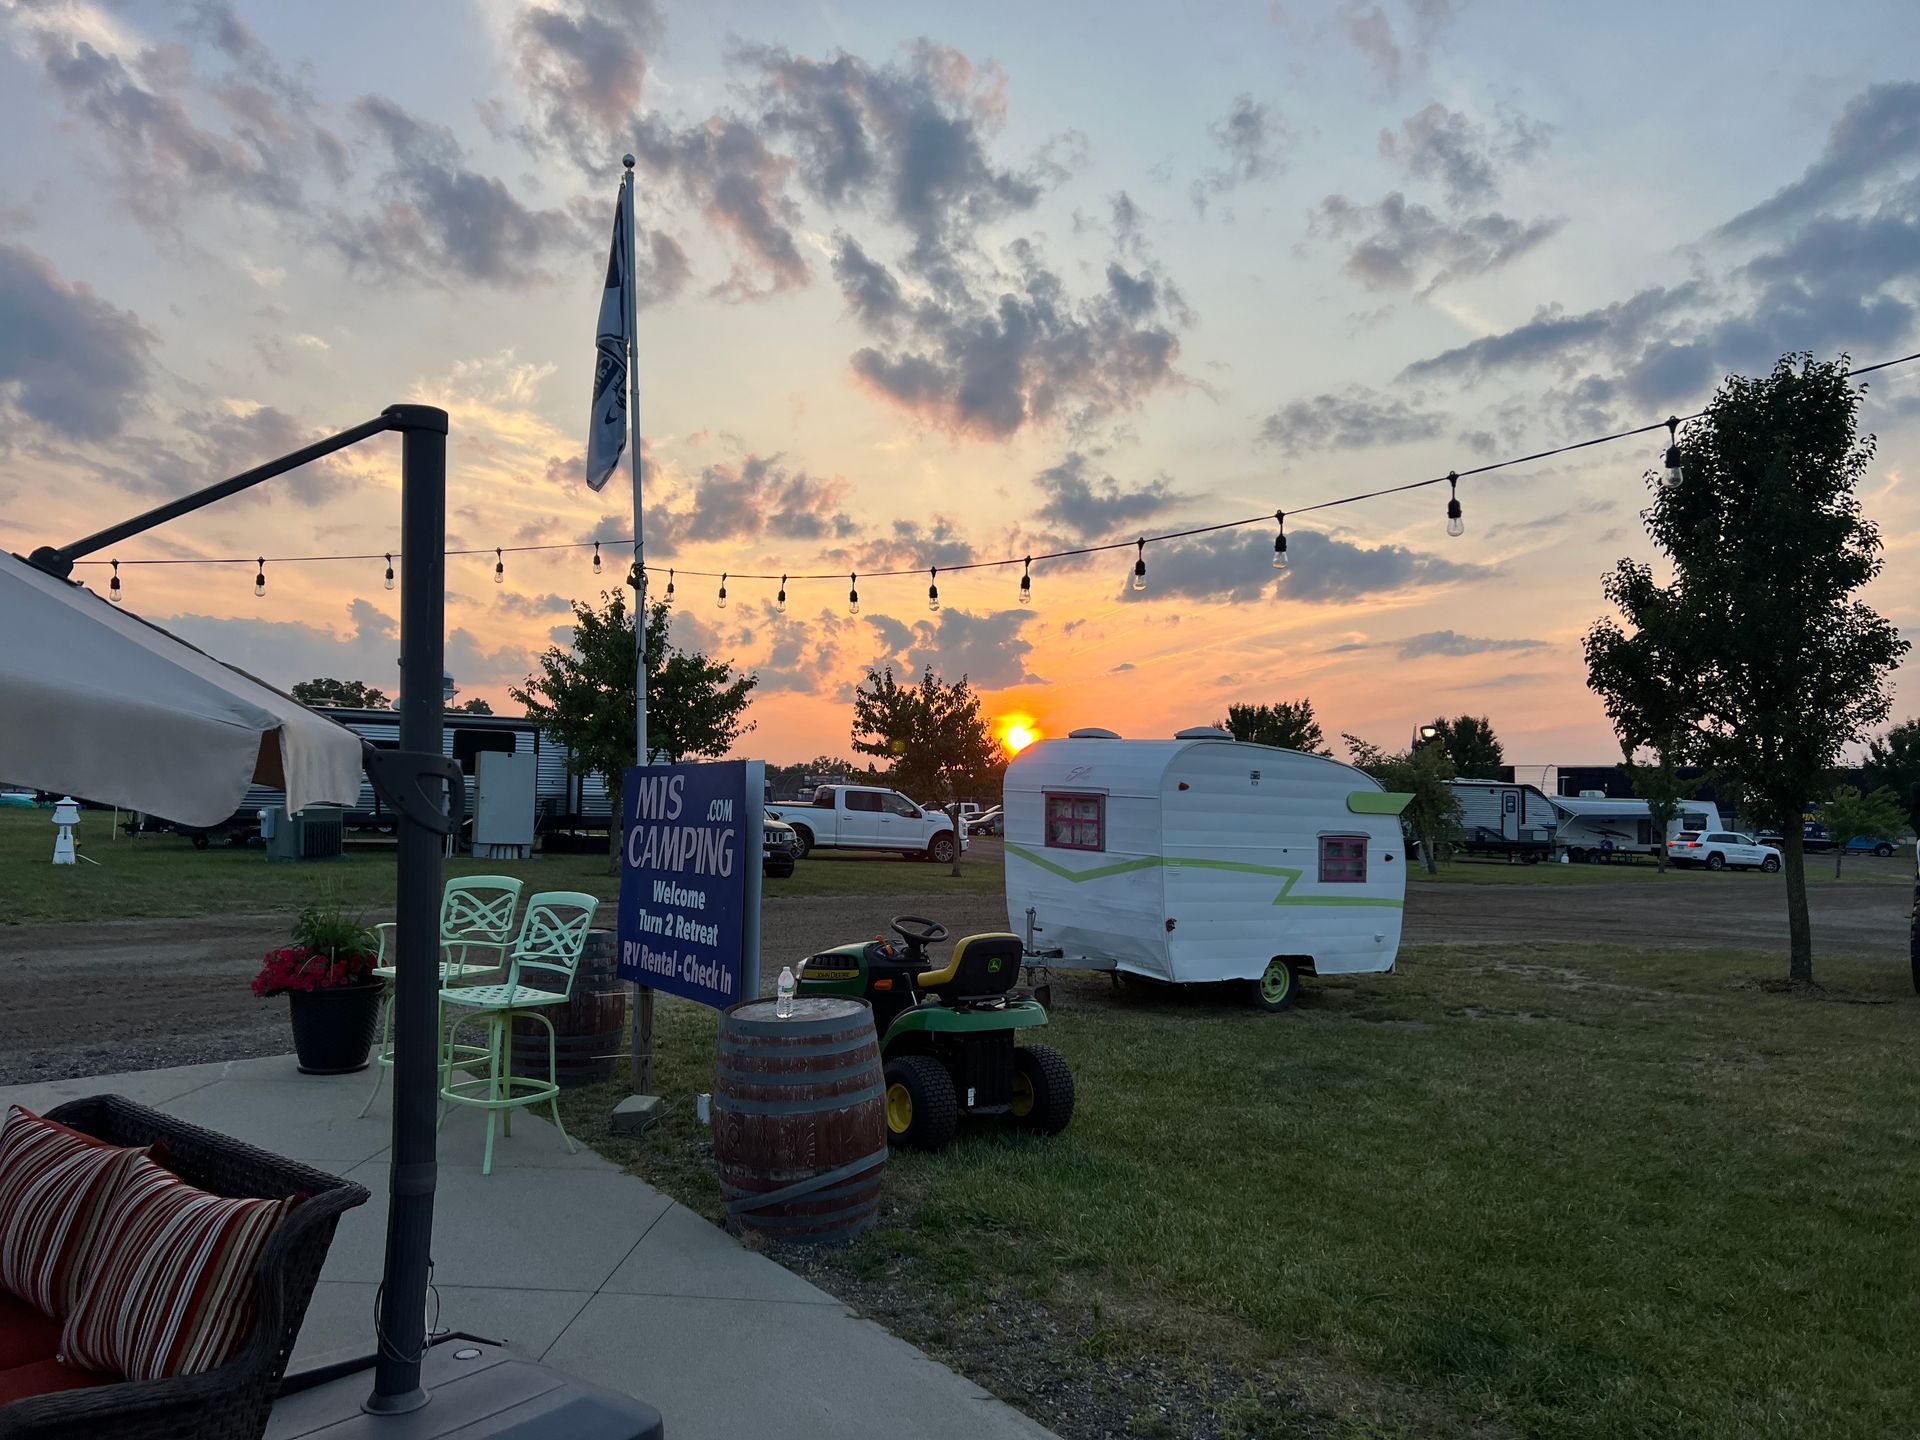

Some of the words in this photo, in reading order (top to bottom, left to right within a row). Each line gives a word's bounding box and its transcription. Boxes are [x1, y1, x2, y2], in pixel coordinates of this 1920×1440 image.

[636, 774, 685, 820] MIS
[706, 799, 733, 822] .COM
[628, 825, 735, 877] CAMPING
[653, 880, 706, 910] Welcome
[639, 908, 663, 934] Turn
[664, 913, 674, 937] 2
[675, 915, 719, 947] Retreat
[623, 940, 641, 967] RV
[640, 944, 678, 978] Rental
[683, 954, 720, 991] Check
[720, 964, 732, 995] In
